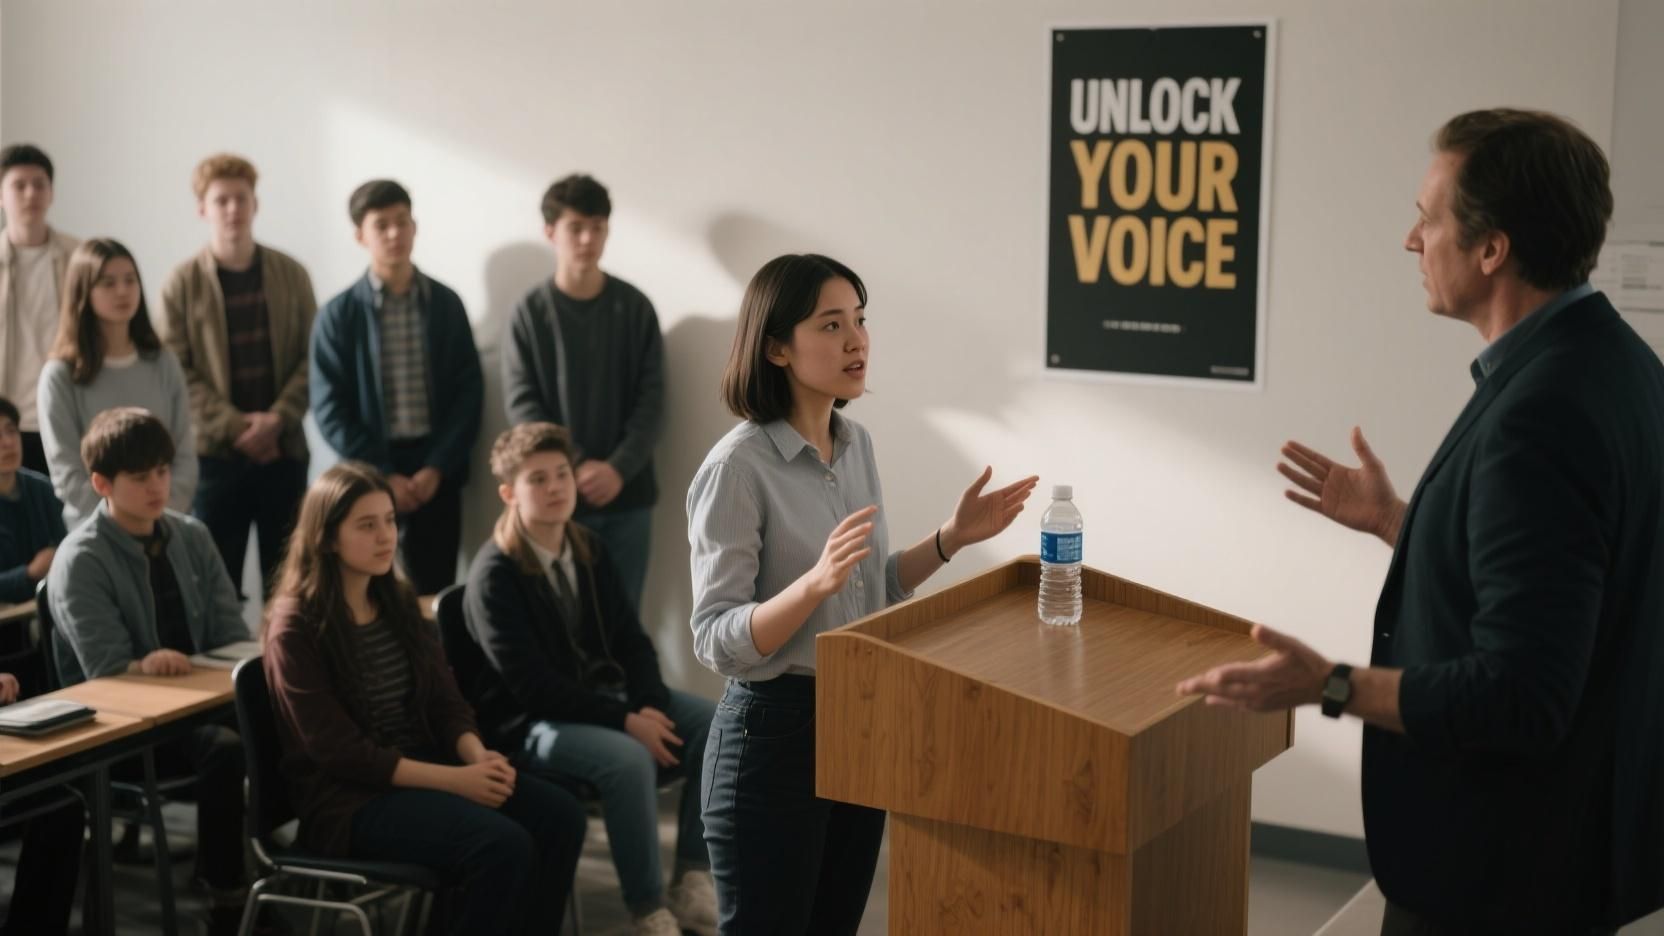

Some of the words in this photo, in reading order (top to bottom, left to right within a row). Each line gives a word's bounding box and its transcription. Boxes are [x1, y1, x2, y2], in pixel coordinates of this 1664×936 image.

[1070, 77, 1241, 135] UNLOCK
[1070, 138, 1239, 212] YOUR
[1068, 214, 1239, 289] VOICE
